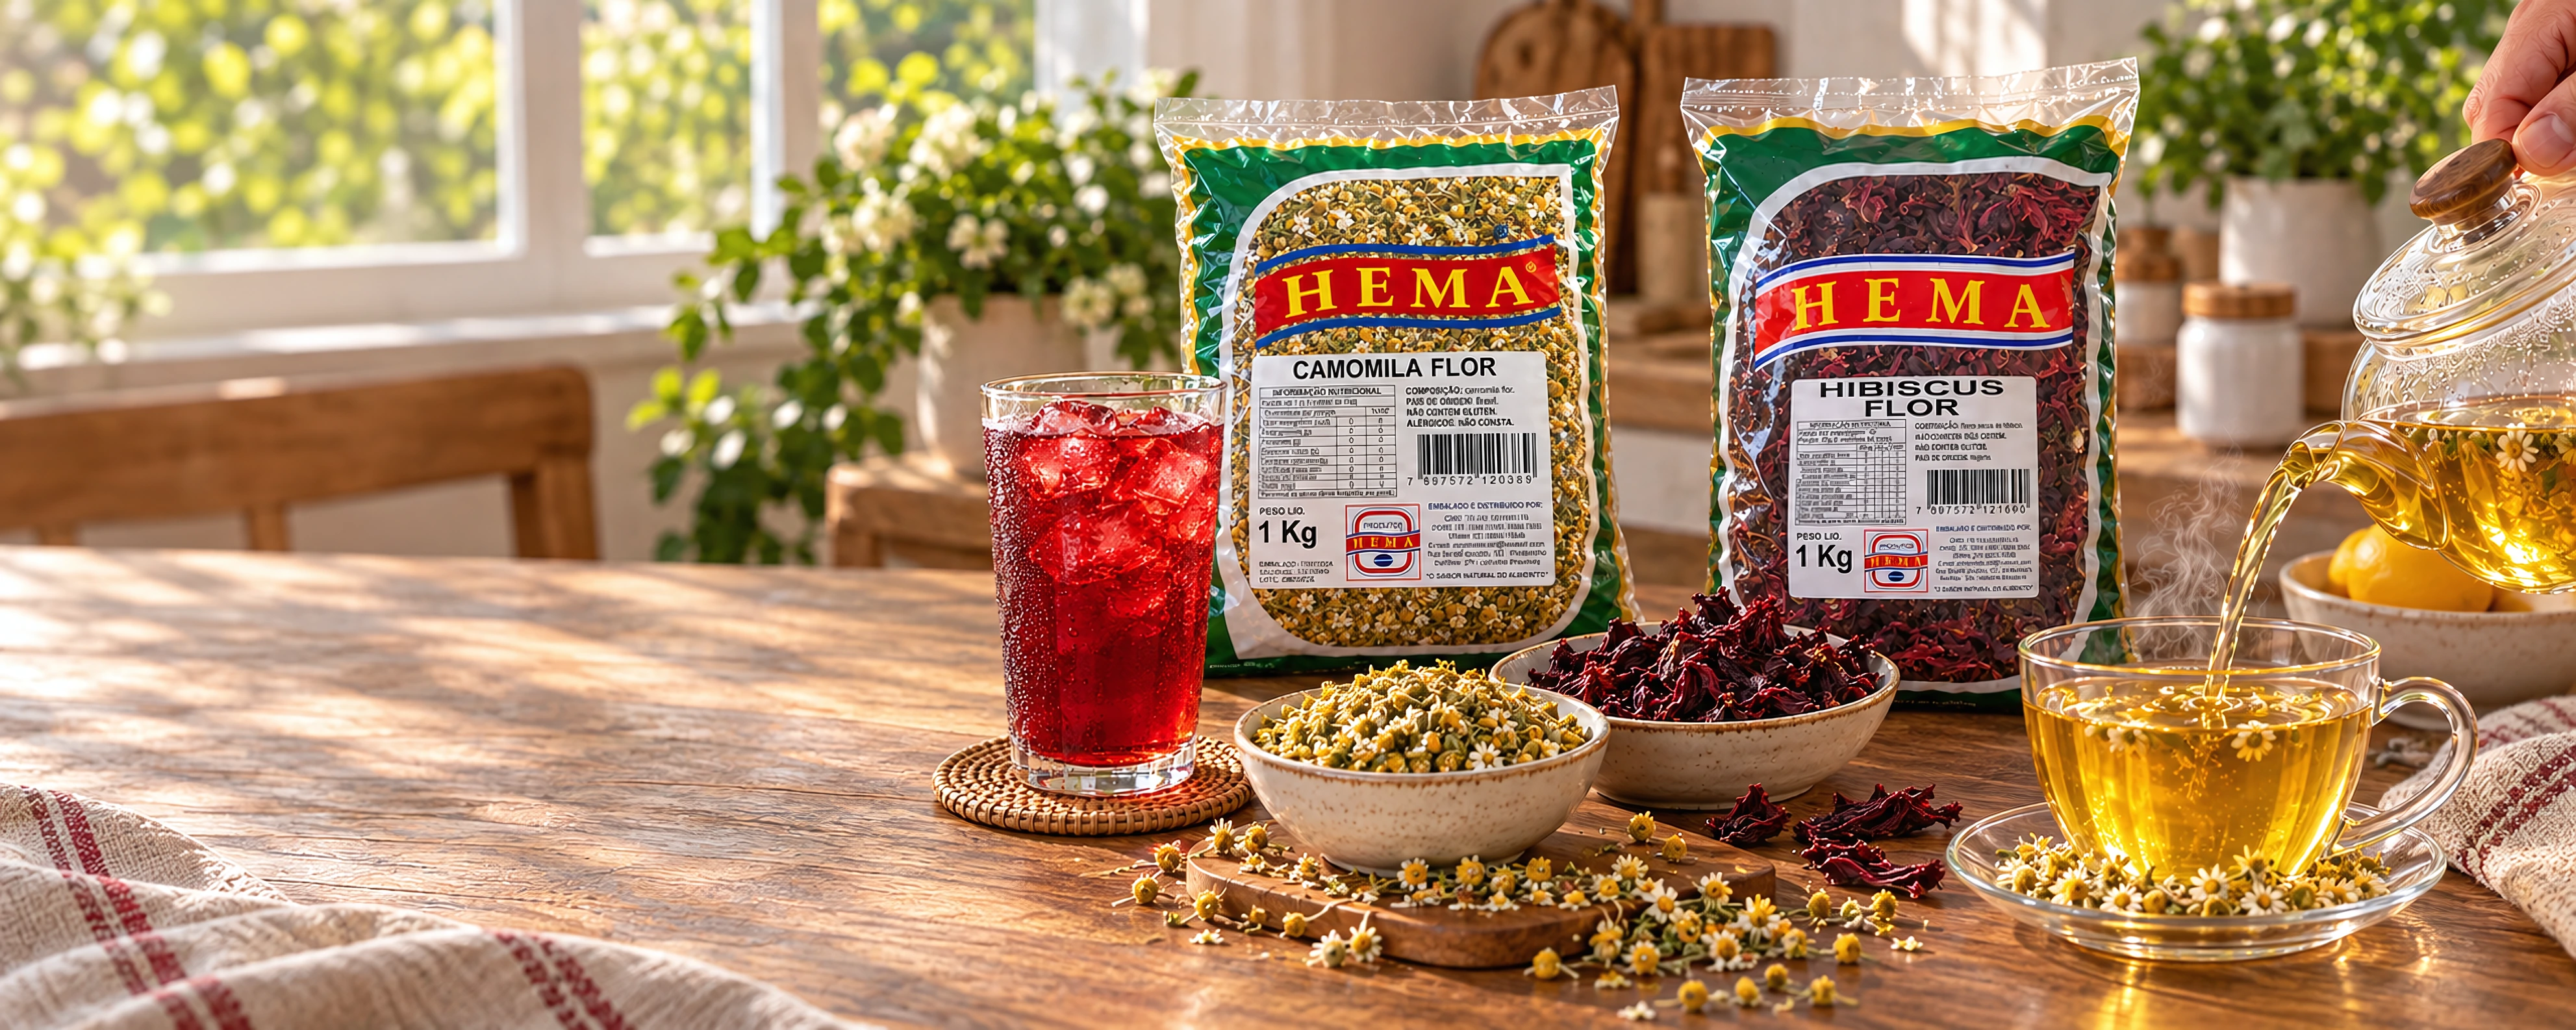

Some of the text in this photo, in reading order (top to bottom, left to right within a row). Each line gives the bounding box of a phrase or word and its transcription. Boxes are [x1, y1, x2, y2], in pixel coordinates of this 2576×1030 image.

[1282, 266, 1534, 318] HEMA
[1791, 277, 2051, 332] HEMA
[1293, 357, 1497, 380] CAMOMILA FLOR
[1820, 379, 2004, 397] HIBISCUS
[1865, 399, 1960, 417] FLOR
[1407, 477, 1413, 486] 7
[1259, 520, 1317, 549] 1 Kg
[1796, 544, 1852, 573] 1 Kg
